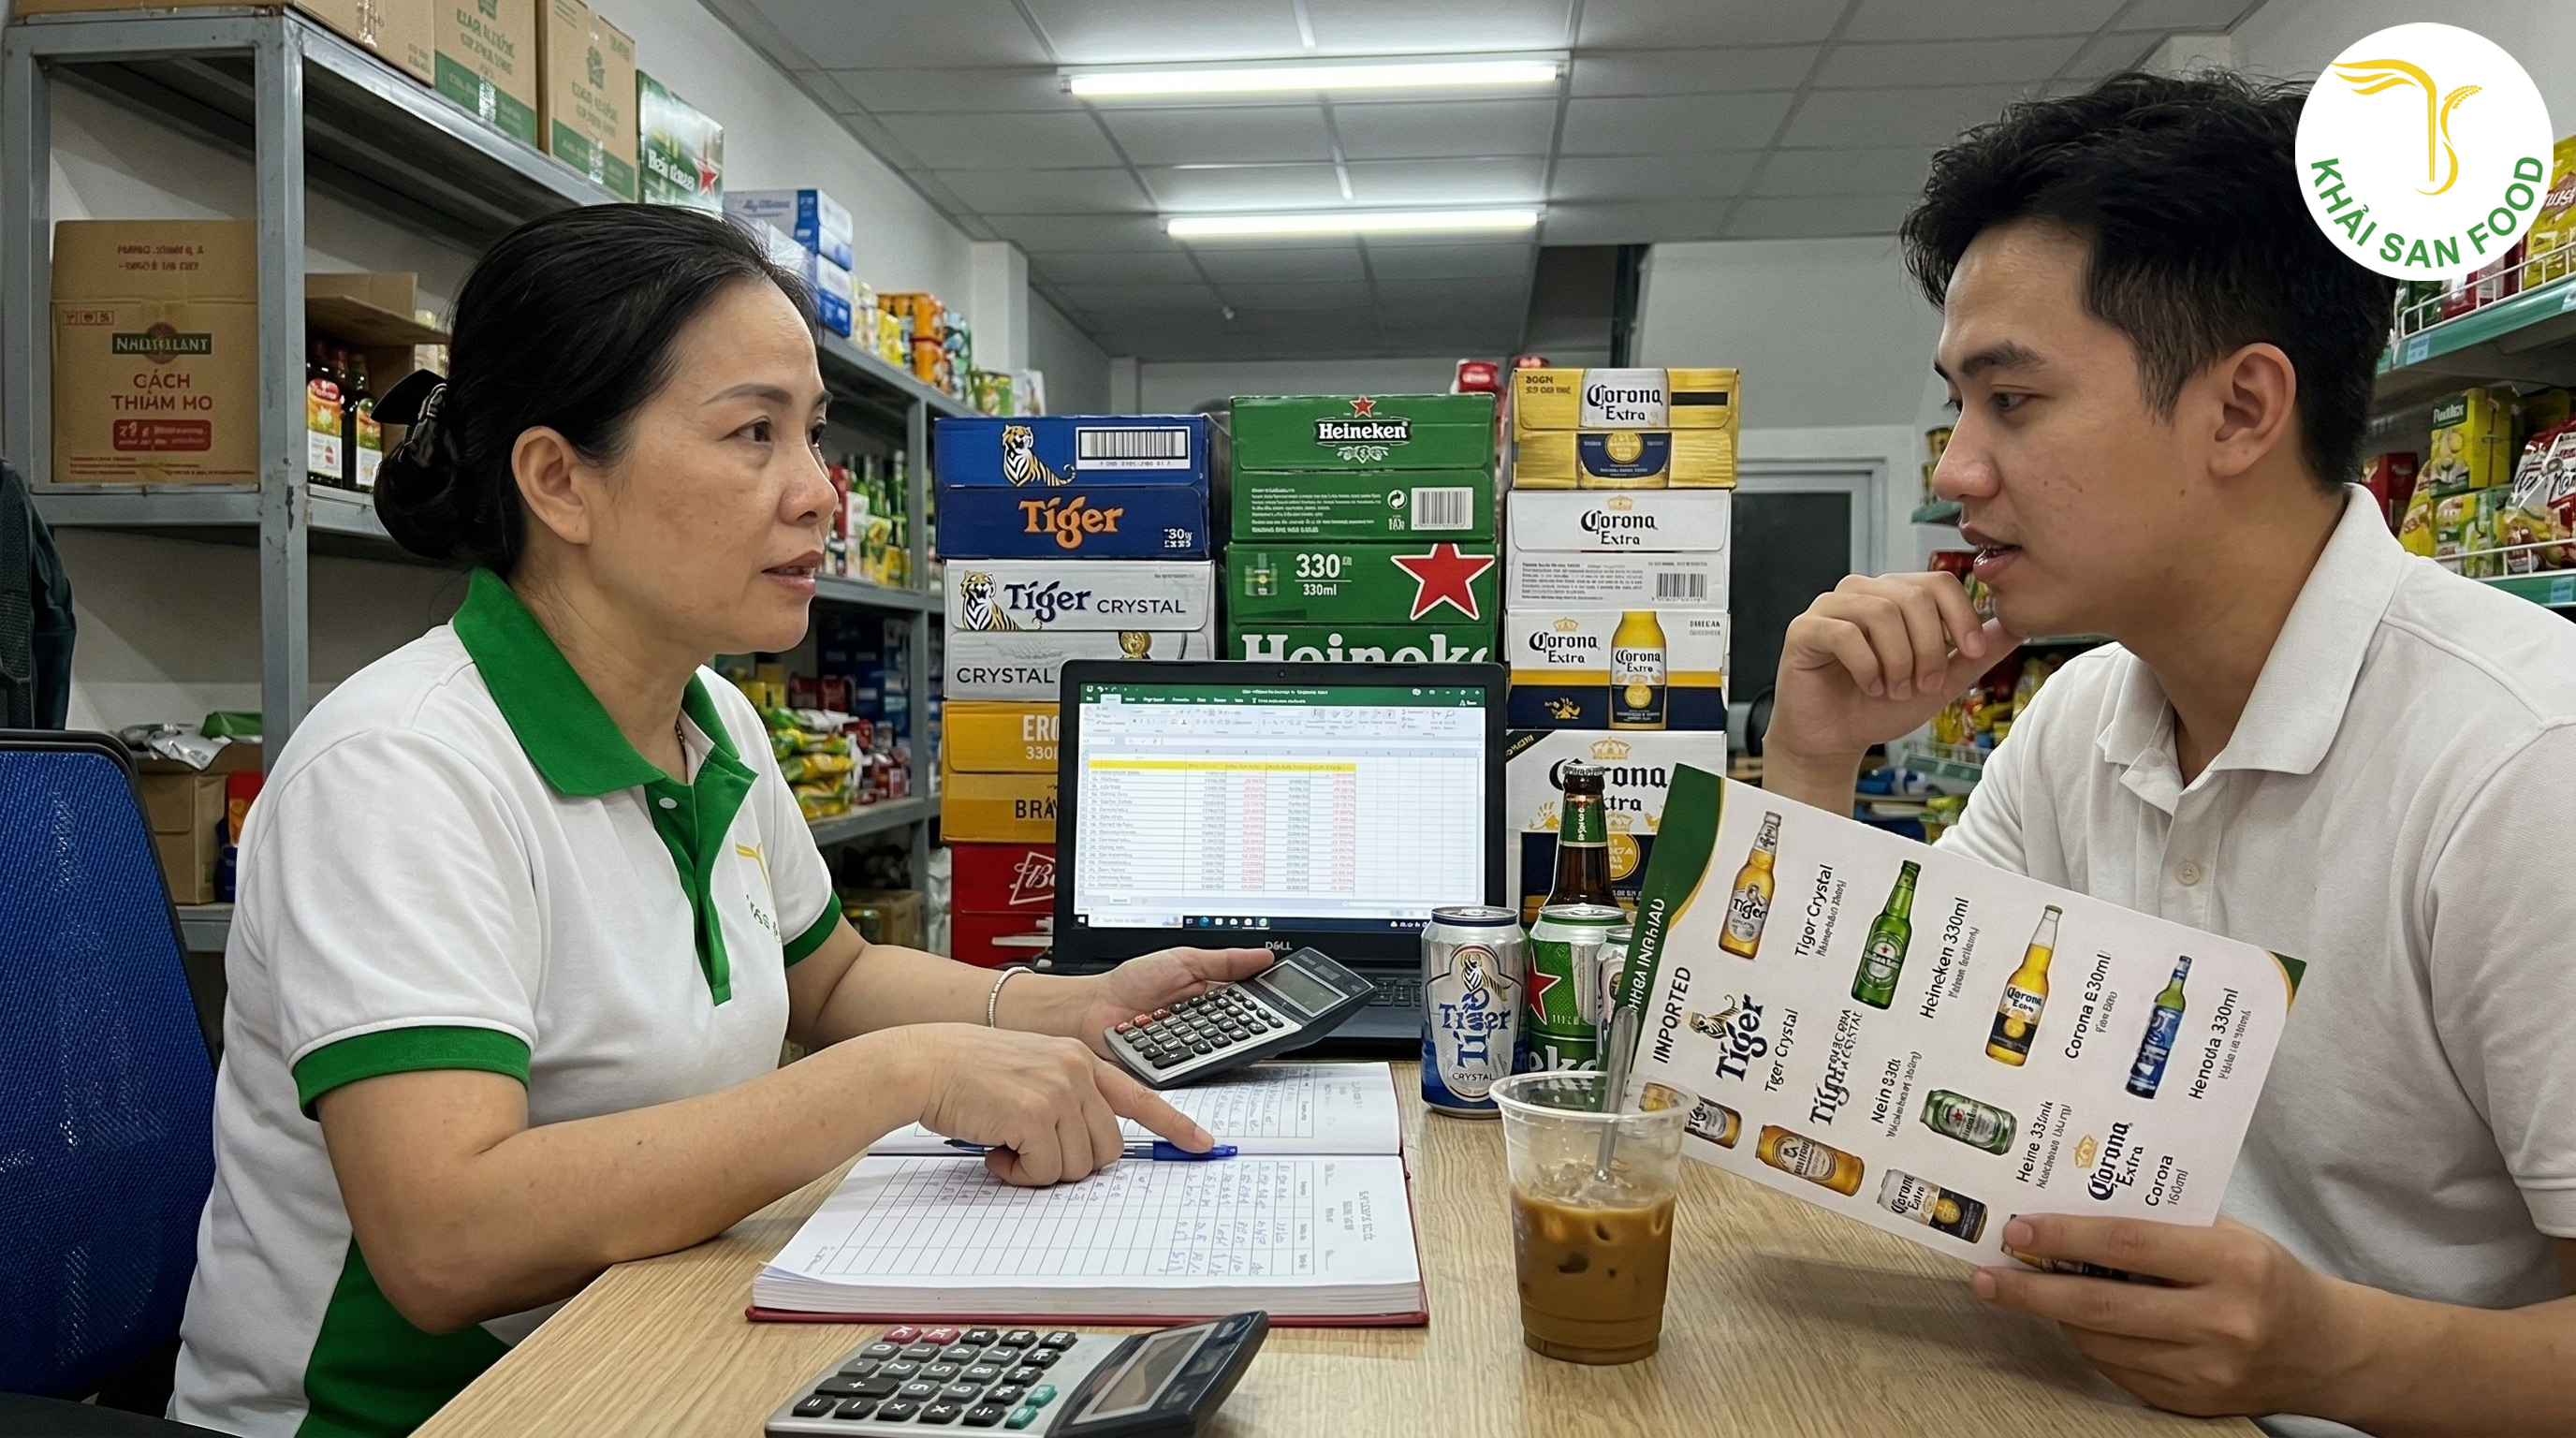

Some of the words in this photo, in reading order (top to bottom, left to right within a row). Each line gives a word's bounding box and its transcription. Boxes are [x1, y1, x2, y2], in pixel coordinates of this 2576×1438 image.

[1587, 383, 1663, 409] Corona
[1605, 405, 1646, 420] Extra
[1318, 422, 1407, 440] Heineken
[1017, 495, 1124, 550] Tiger
[1580, 509, 1659, 535] Corona
[1600, 531, 1641, 545] Extra
[1295, 553, 1340, 579] 330
[1003, 580, 1091, 623] Tiger
[1096, 599, 1186, 613] CRYSTAL
[1302, 583, 1338, 596] 330ml
[1529, 630, 1601, 653] Corona
[1547, 651, 1586, 664] Extra
[1616, 649, 1661, 665] Corona
[957, 668, 1055, 684] CRYSTAL
[1549, 758, 1670, 792] Cona
[1807, 864, 1833, 917] Crystal
[1919, 946, 1954, 1019] Heineken
[1942, 897, 1969, 945] 330ml
[2211, 988, 2238, 1034] 330ml
[1715, 993, 1769, 1082] Tiger
[1774, 1008, 1798, 1058] Crystal
[2064, 1005, 2094, 1059] Corona
[1452, 1072, 1496, 1081] CRYSTAL
[1870, 1088, 1893, 1124] Nein
[2015, 1142, 2041, 1183] Heine
[2087, 1122, 2131, 1201] Corona
